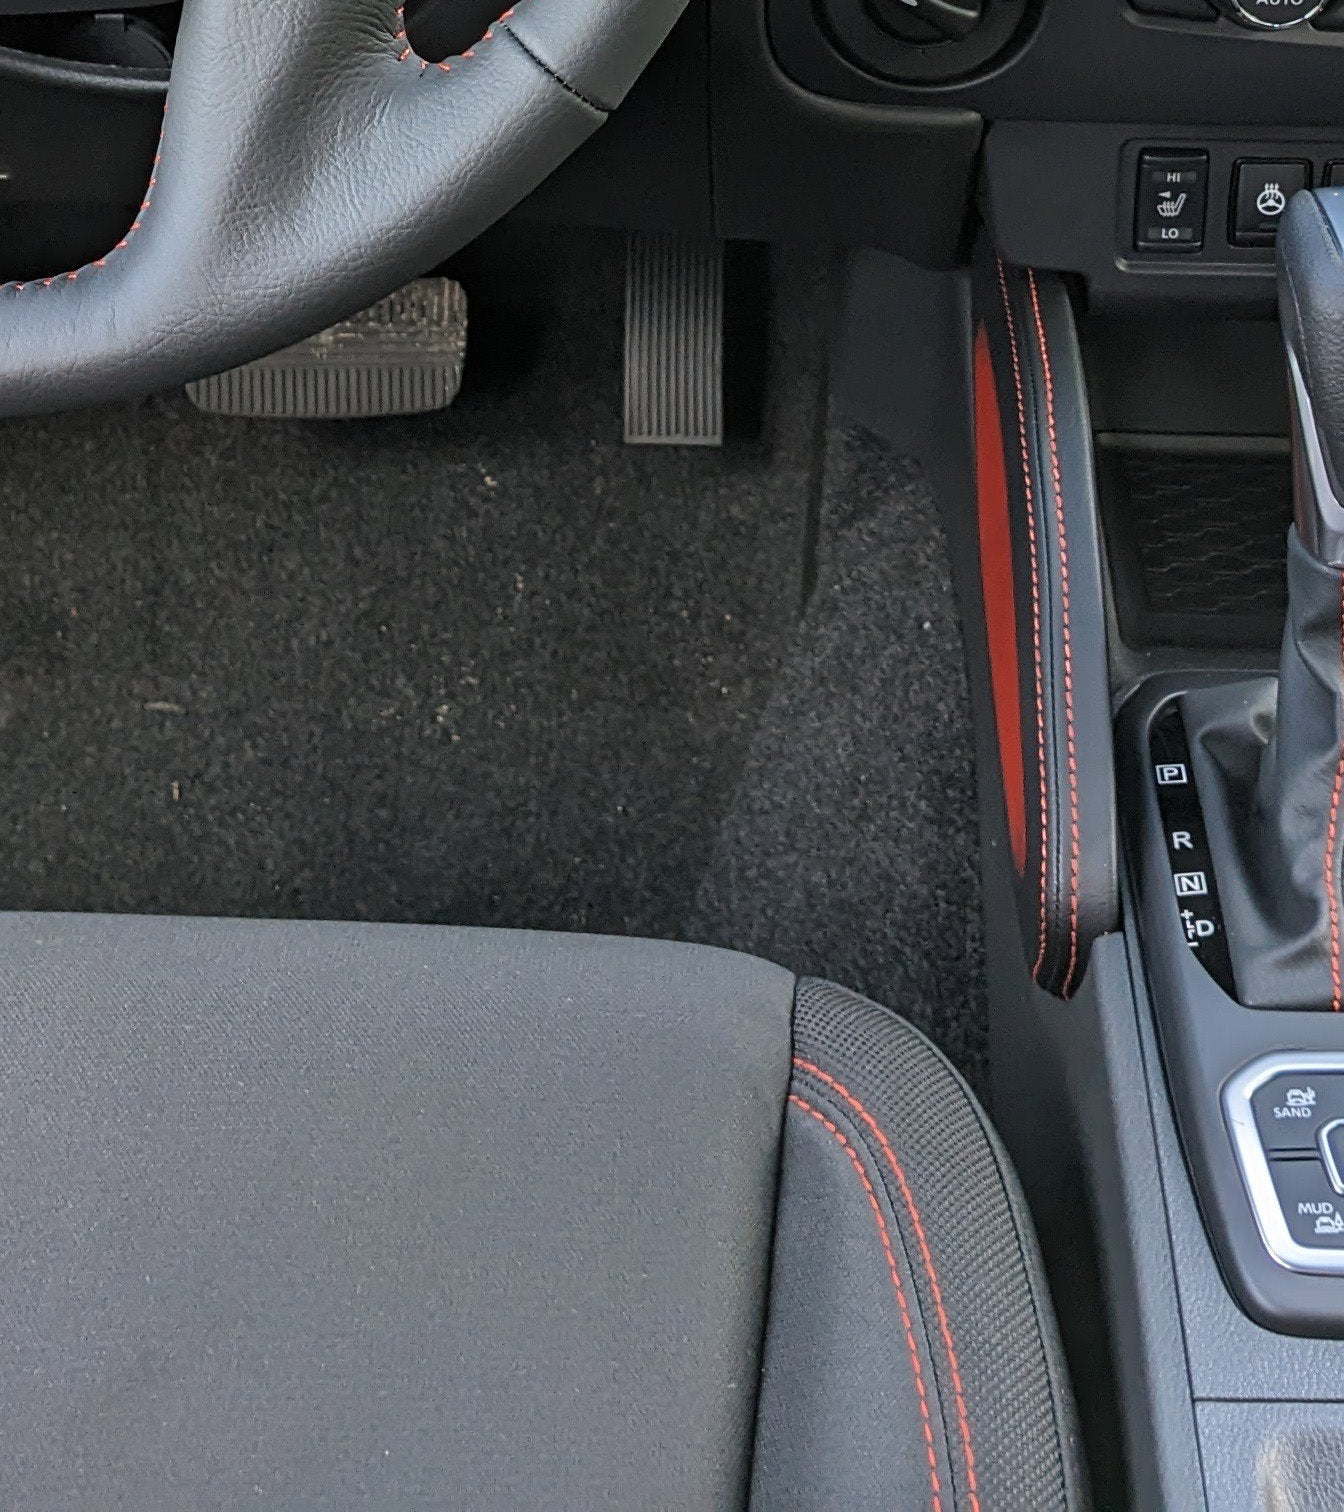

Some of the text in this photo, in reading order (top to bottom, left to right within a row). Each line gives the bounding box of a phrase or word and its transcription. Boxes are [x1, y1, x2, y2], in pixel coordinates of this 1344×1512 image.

[1166, 171, 1181, 183] HI
[1161, 227, 1179, 240] LO
[1163, 767, 1180, 782] P
[1172, 831, 1194, 851] R
[1195, 919, 1215, 937] D
[1273, 1106, 1312, 1119] SAND
[1298, 1202, 1334, 1215] MUD
